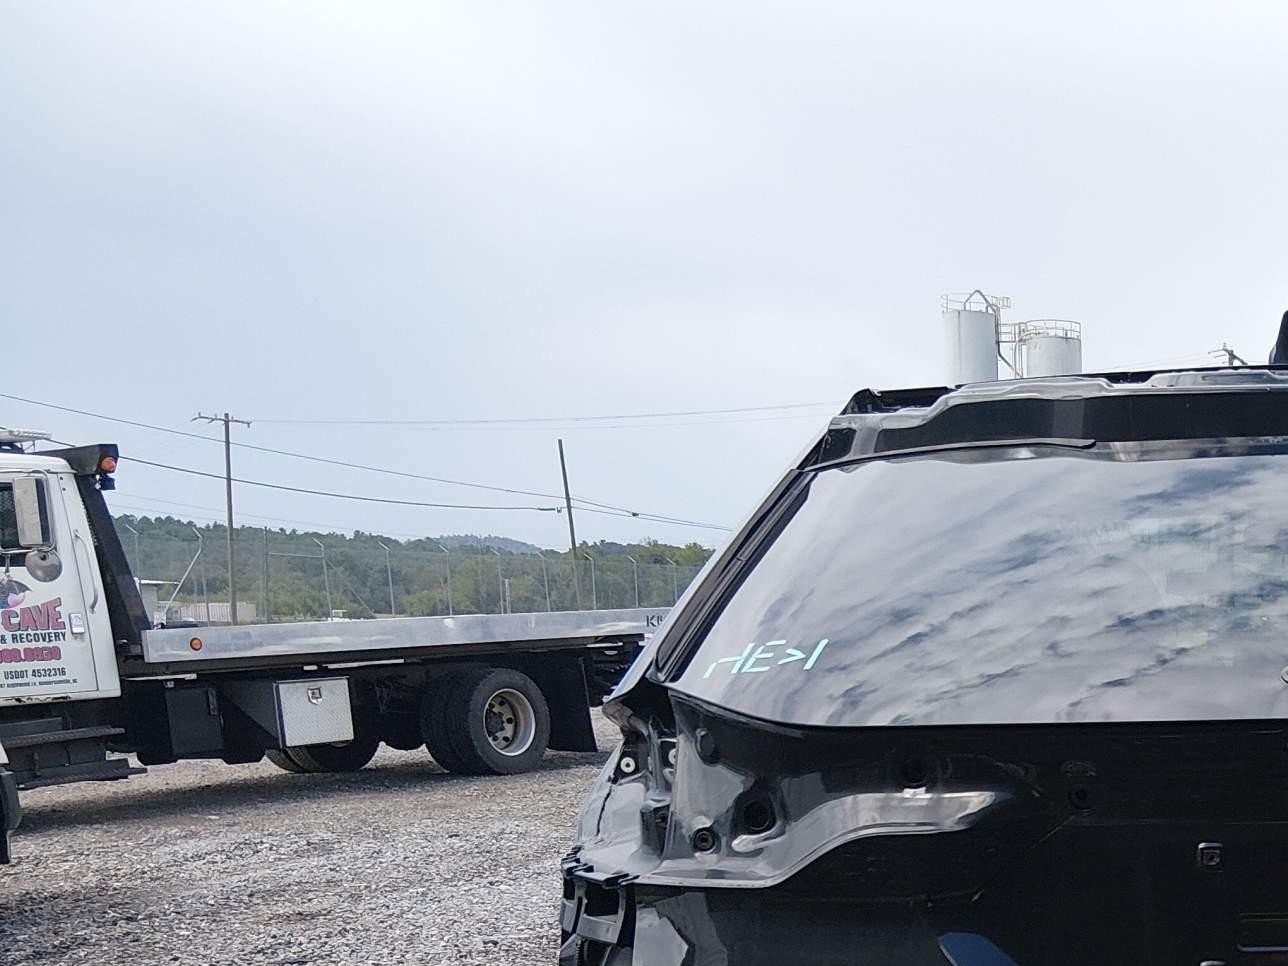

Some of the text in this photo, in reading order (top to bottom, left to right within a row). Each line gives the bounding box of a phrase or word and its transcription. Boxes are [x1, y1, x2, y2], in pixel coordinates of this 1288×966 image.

[1, 597, 66, 632] CAVE
[0, 632, 66, 644] & RECOVERY
[4, 667, 66, 680] USDOT 4532316
